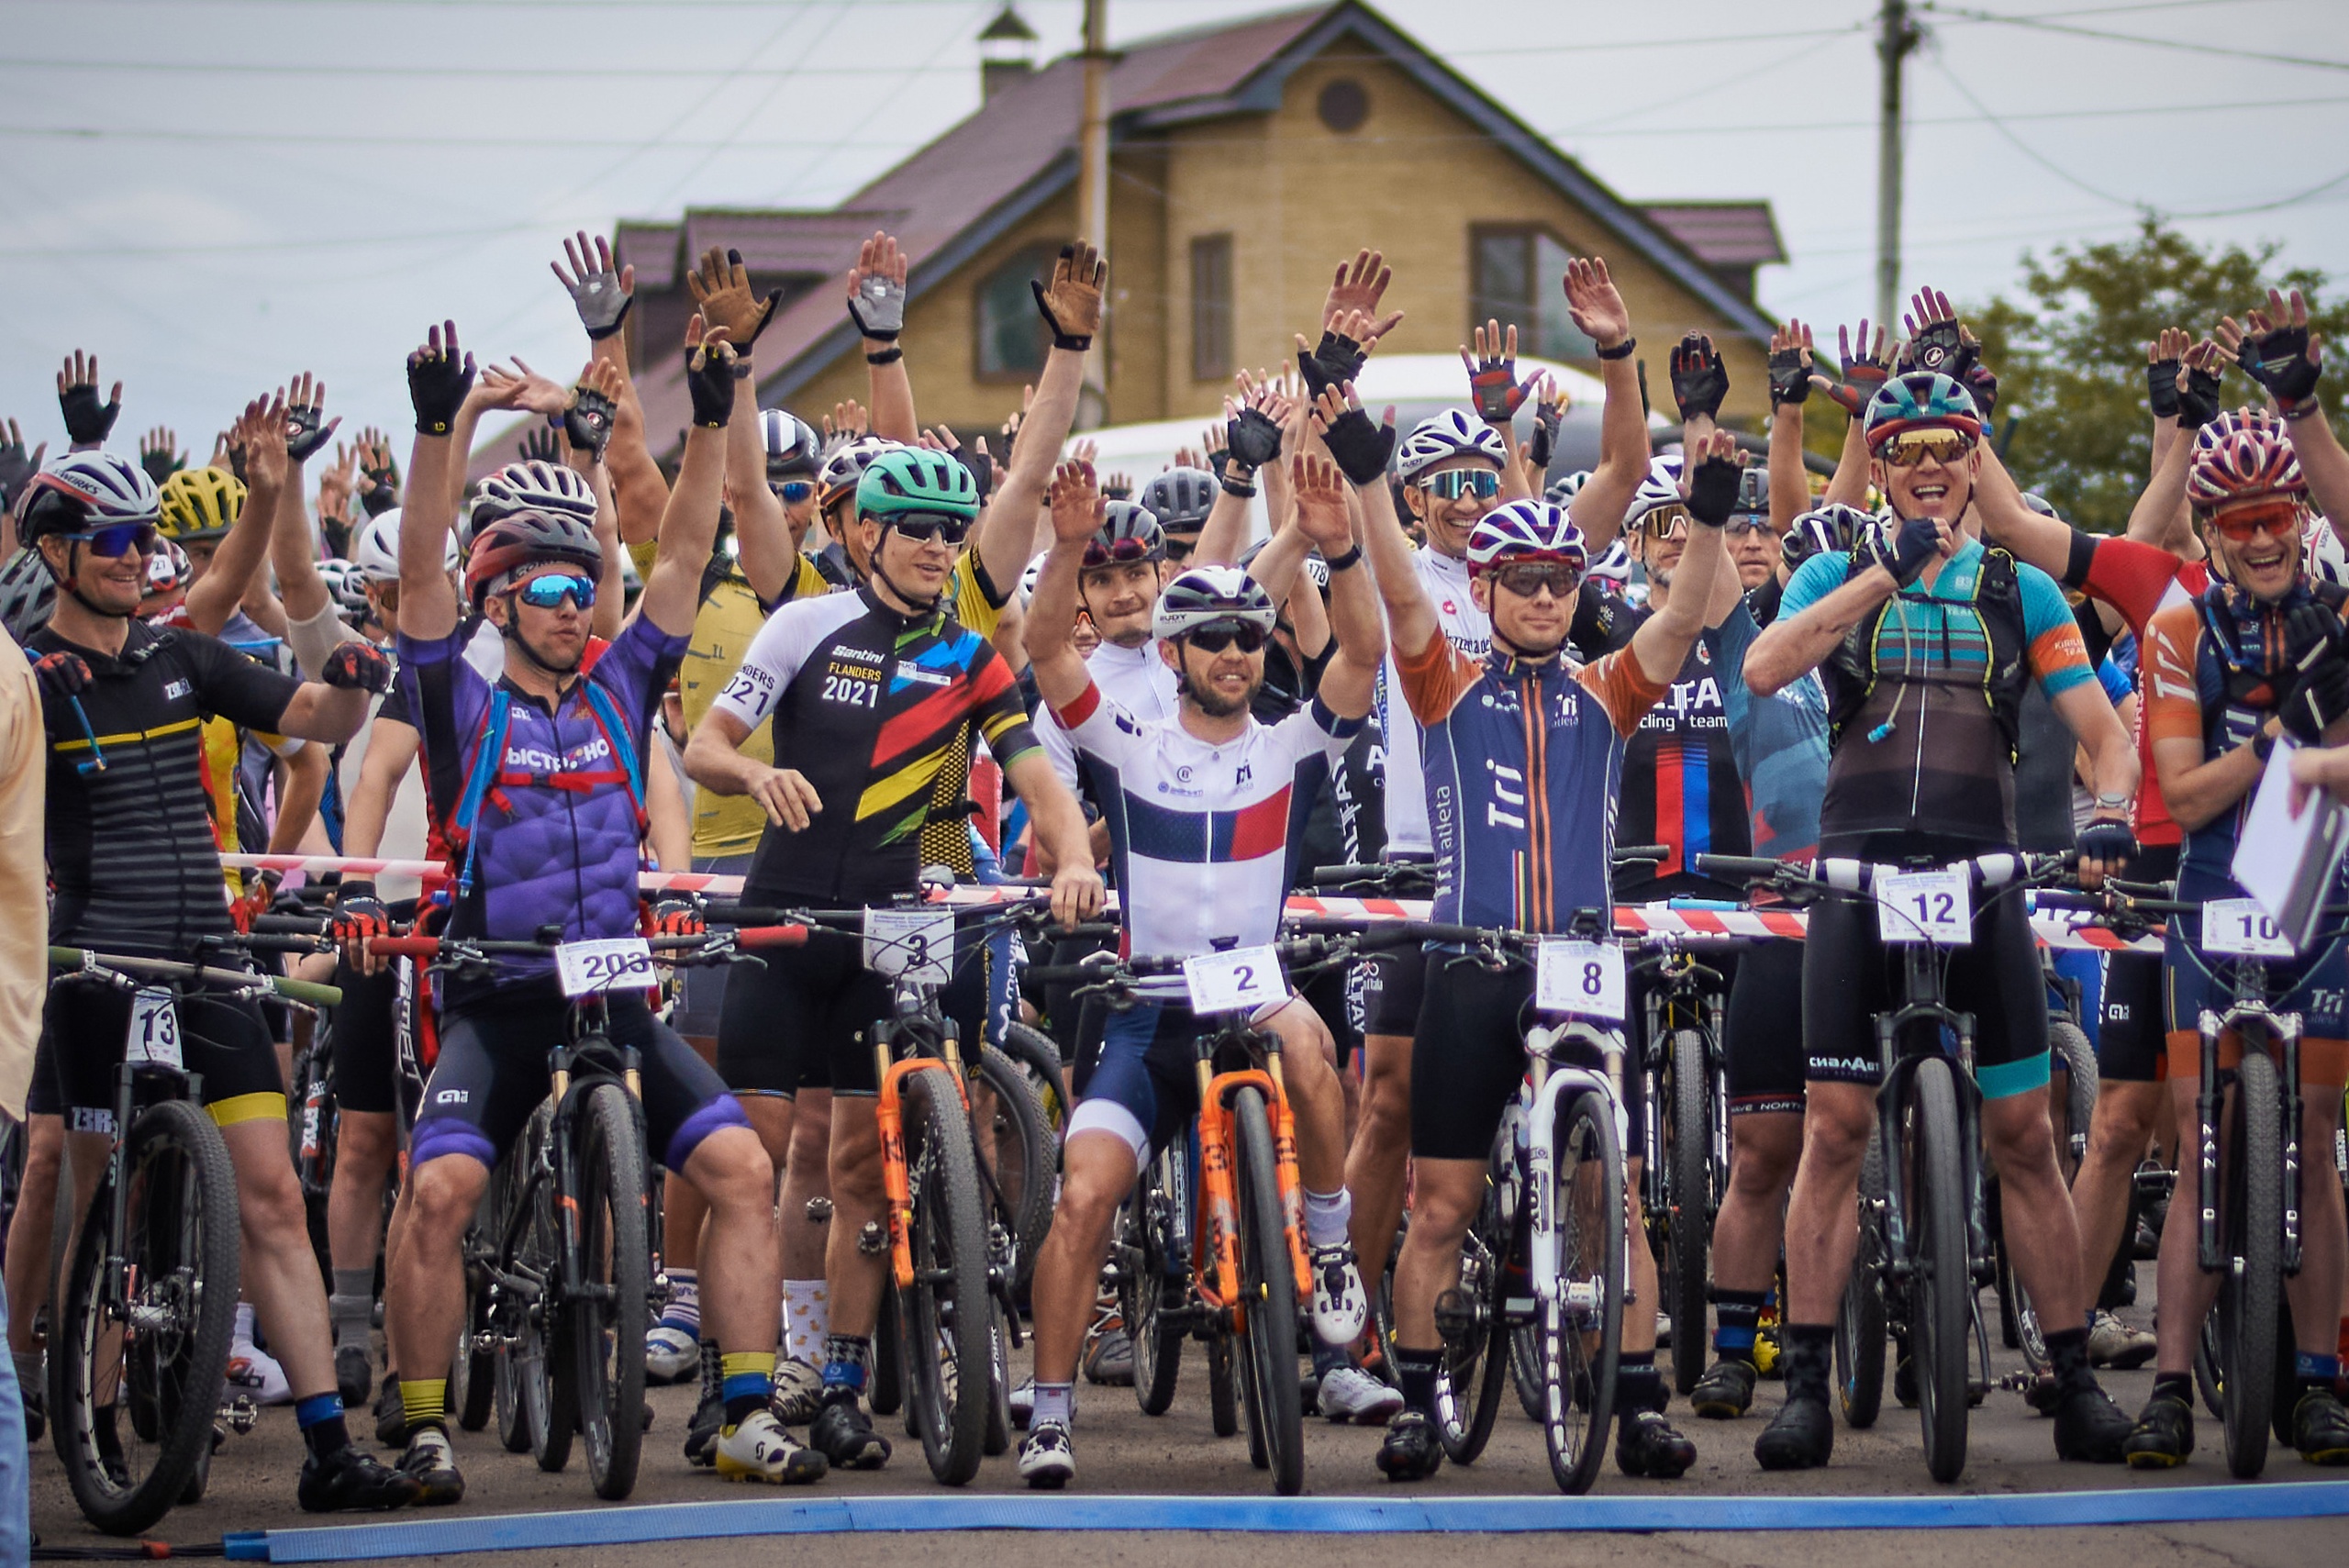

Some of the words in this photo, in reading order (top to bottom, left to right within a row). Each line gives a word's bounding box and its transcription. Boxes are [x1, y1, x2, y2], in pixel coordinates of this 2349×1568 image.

[1308, 562, 1328, 584] 178
[832, 644, 886, 664] Santini
[829, 662, 883, 683] FLANDERS
[822, 675, 879, 708] 2021
[1688, 714, 1727, 728] team
[1486, 758, 1525, 829] Tri
[1911, 892, 1956, 924] 12
[2236, 914, 2279, 940] 10
[907, 934, 928, 966] 3
[583, 951, 651, 979] 203
[1233, 965, 1259, 992] 2
[1582, 962, 1603, 995] 8
[2310, 988, 2345, 1014] Tri
[139, 1007, 176, 1046] 13
